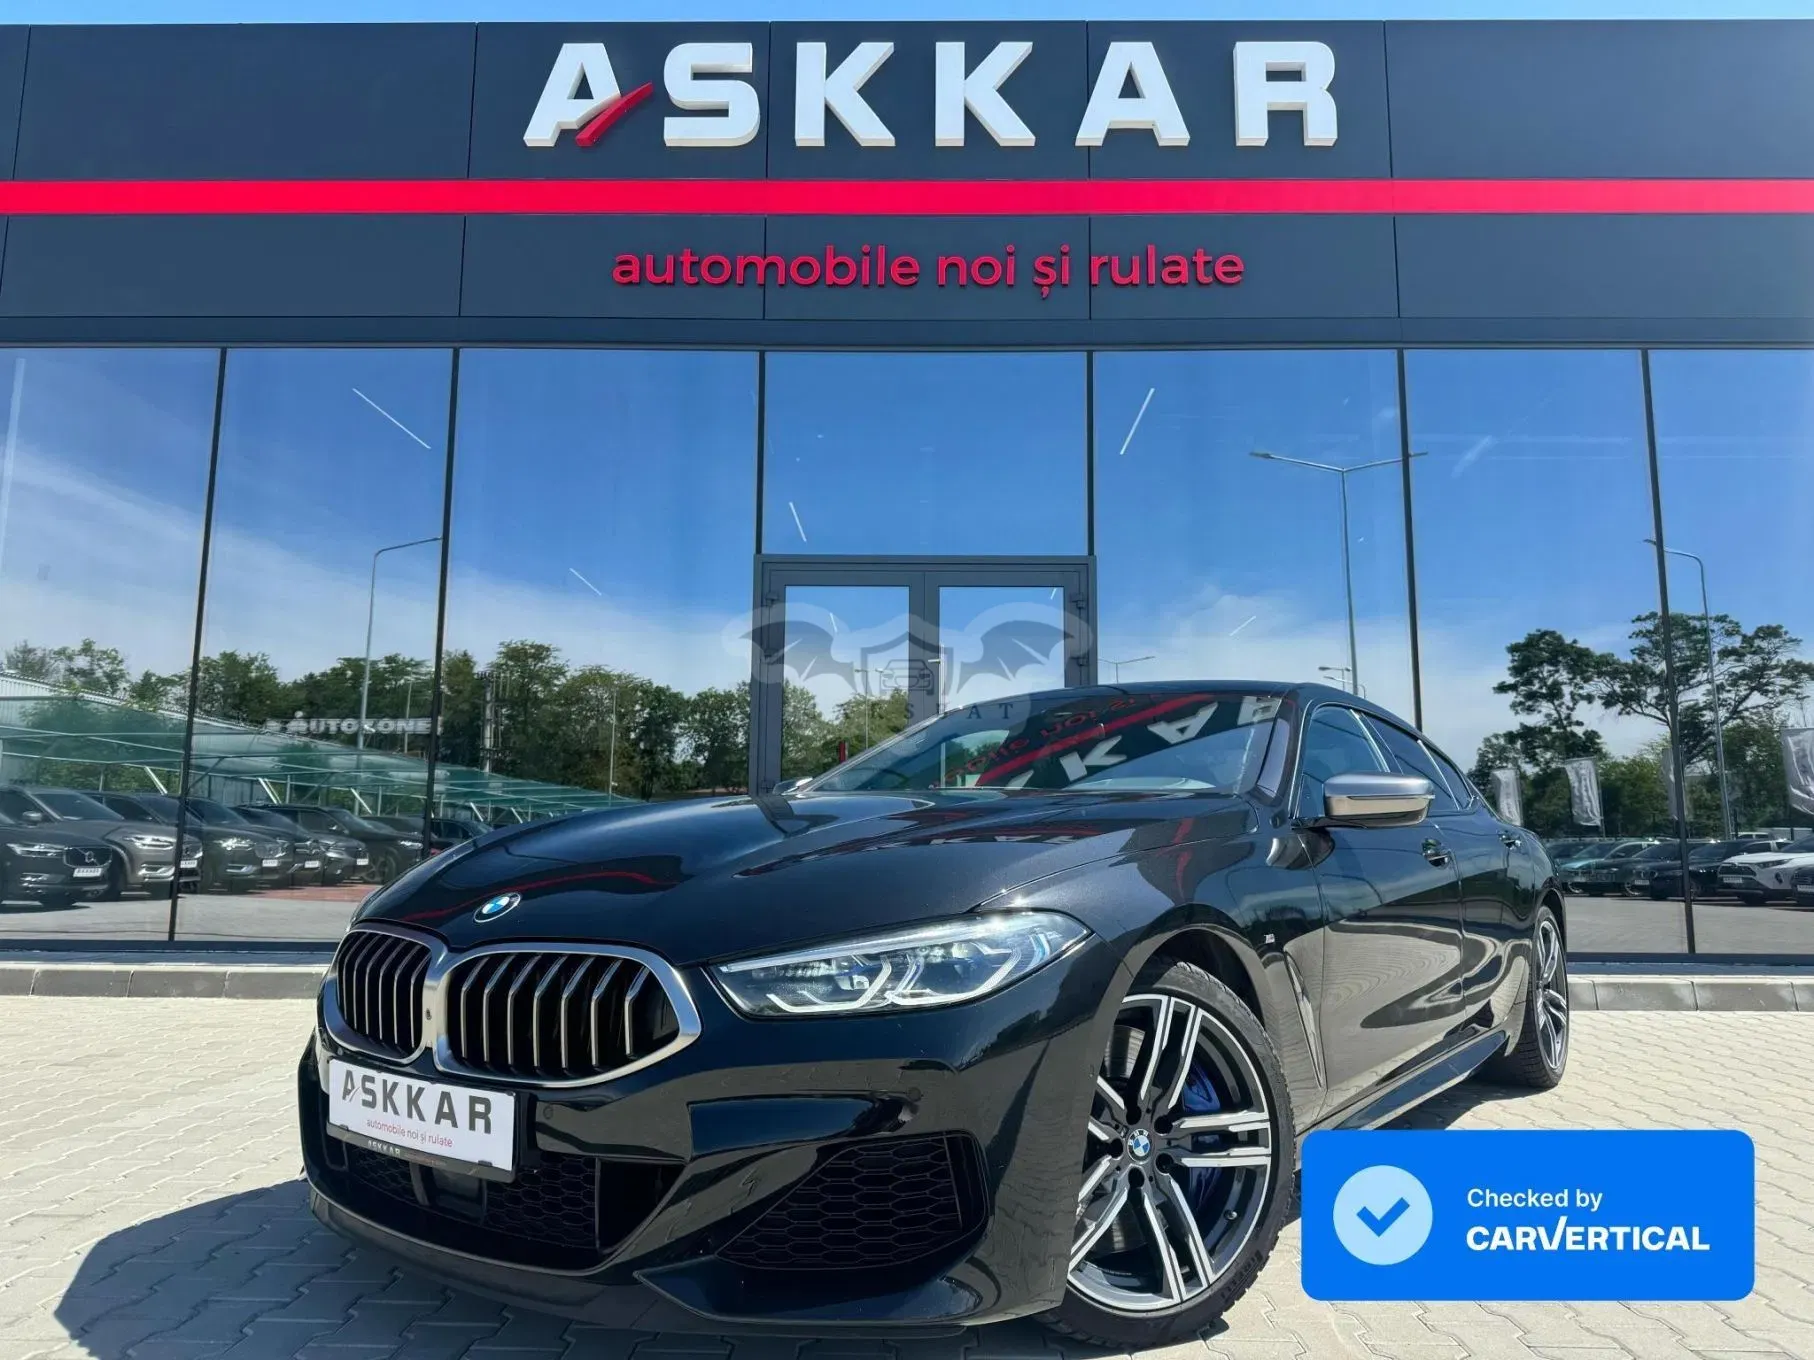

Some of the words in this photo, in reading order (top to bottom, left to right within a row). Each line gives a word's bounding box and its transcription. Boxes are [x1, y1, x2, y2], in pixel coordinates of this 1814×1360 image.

[523, 41, 1339, 147] ASKKAR
[611, 243, 919, 287] automobile
[937, 244, 1016, 287] noi
[1033, 244, 1071, 299] și
[1090, 243, 1245, 287] rulate
[342, 1069, 492, 1134] ASKKAR
[366, 1118, 406, 1137] automobile
[407, 1130, 419, 1142] noi
[428, 1135, 453, 1148] rulate
